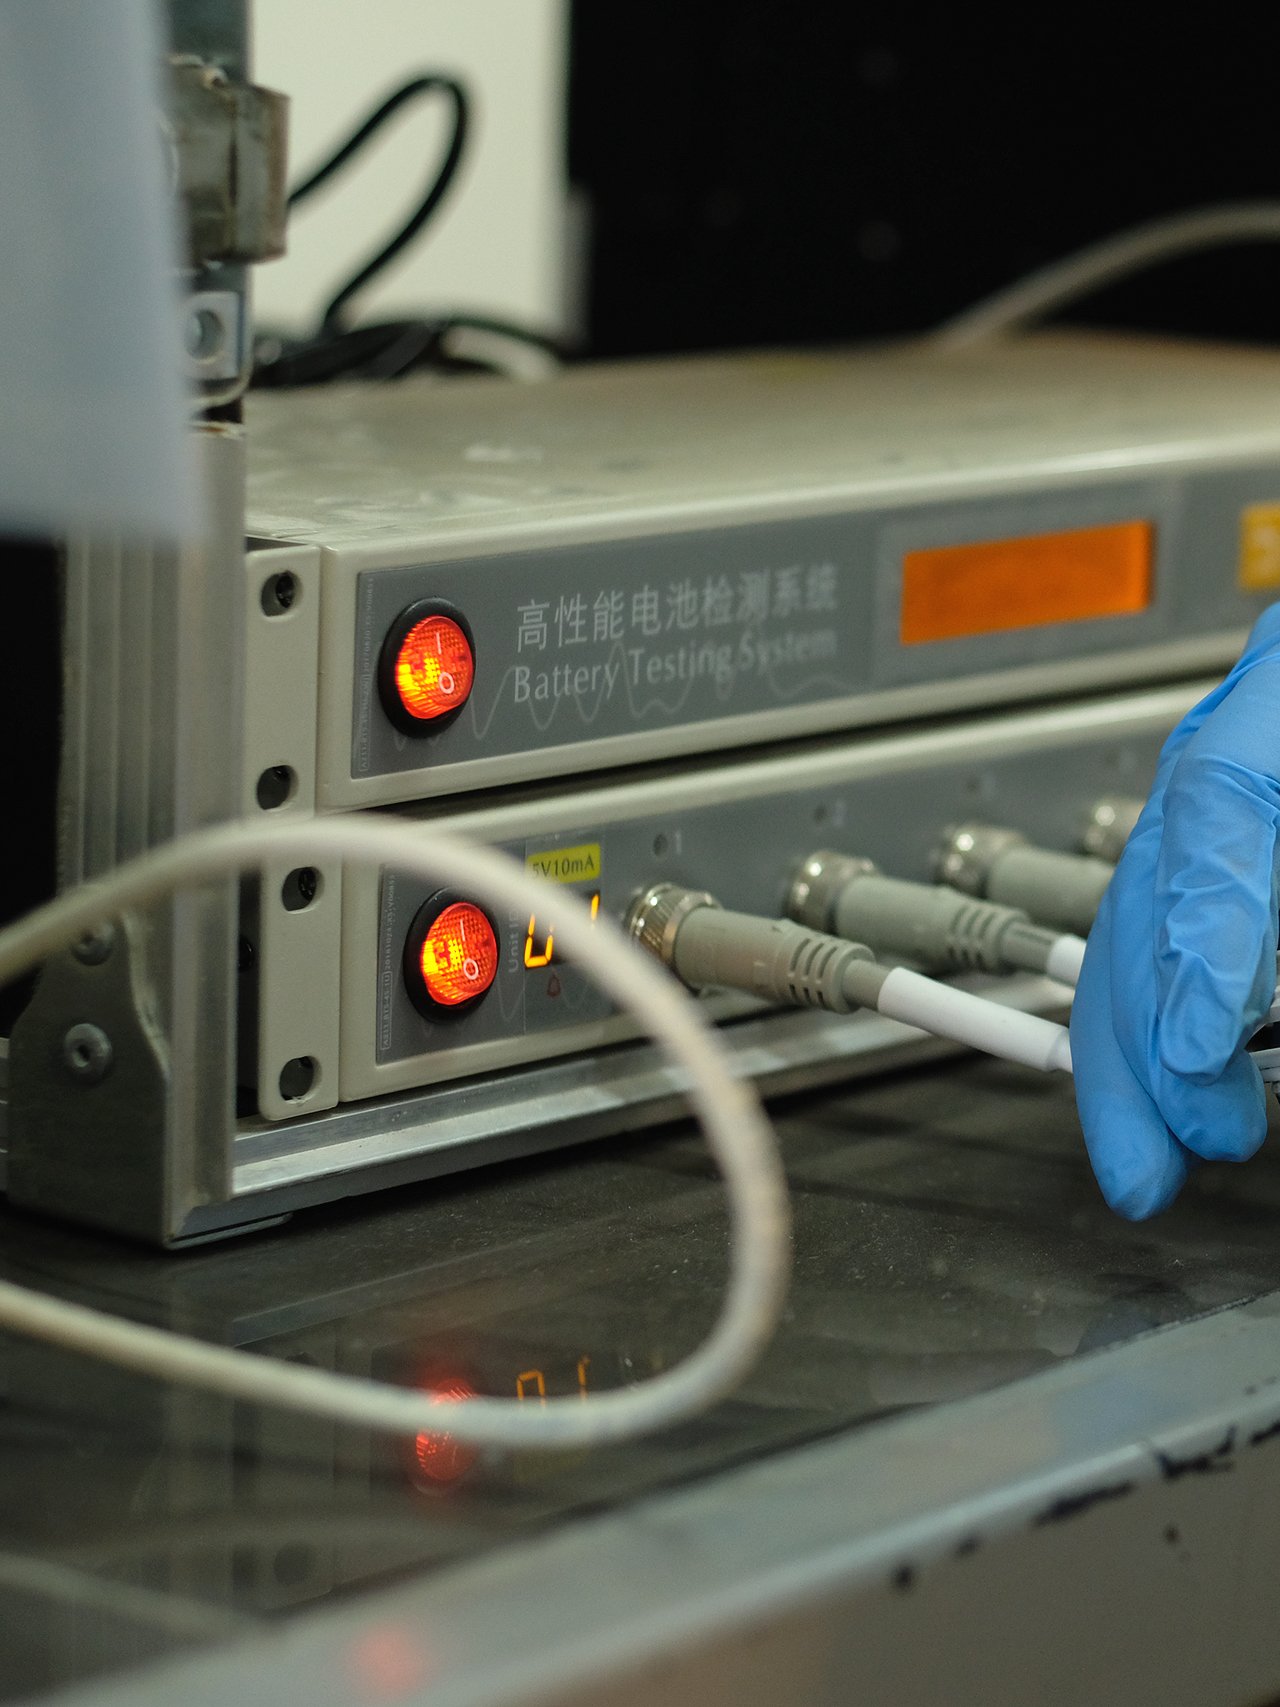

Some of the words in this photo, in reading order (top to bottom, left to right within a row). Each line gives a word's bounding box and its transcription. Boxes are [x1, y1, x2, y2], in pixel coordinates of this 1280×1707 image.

[517, 563, 837, 653] 高性能电池检测系统
[514, 662, 619, 703] Battery
[628, 642, 736, 688] Testing
[738, 628, 837, 677] System
